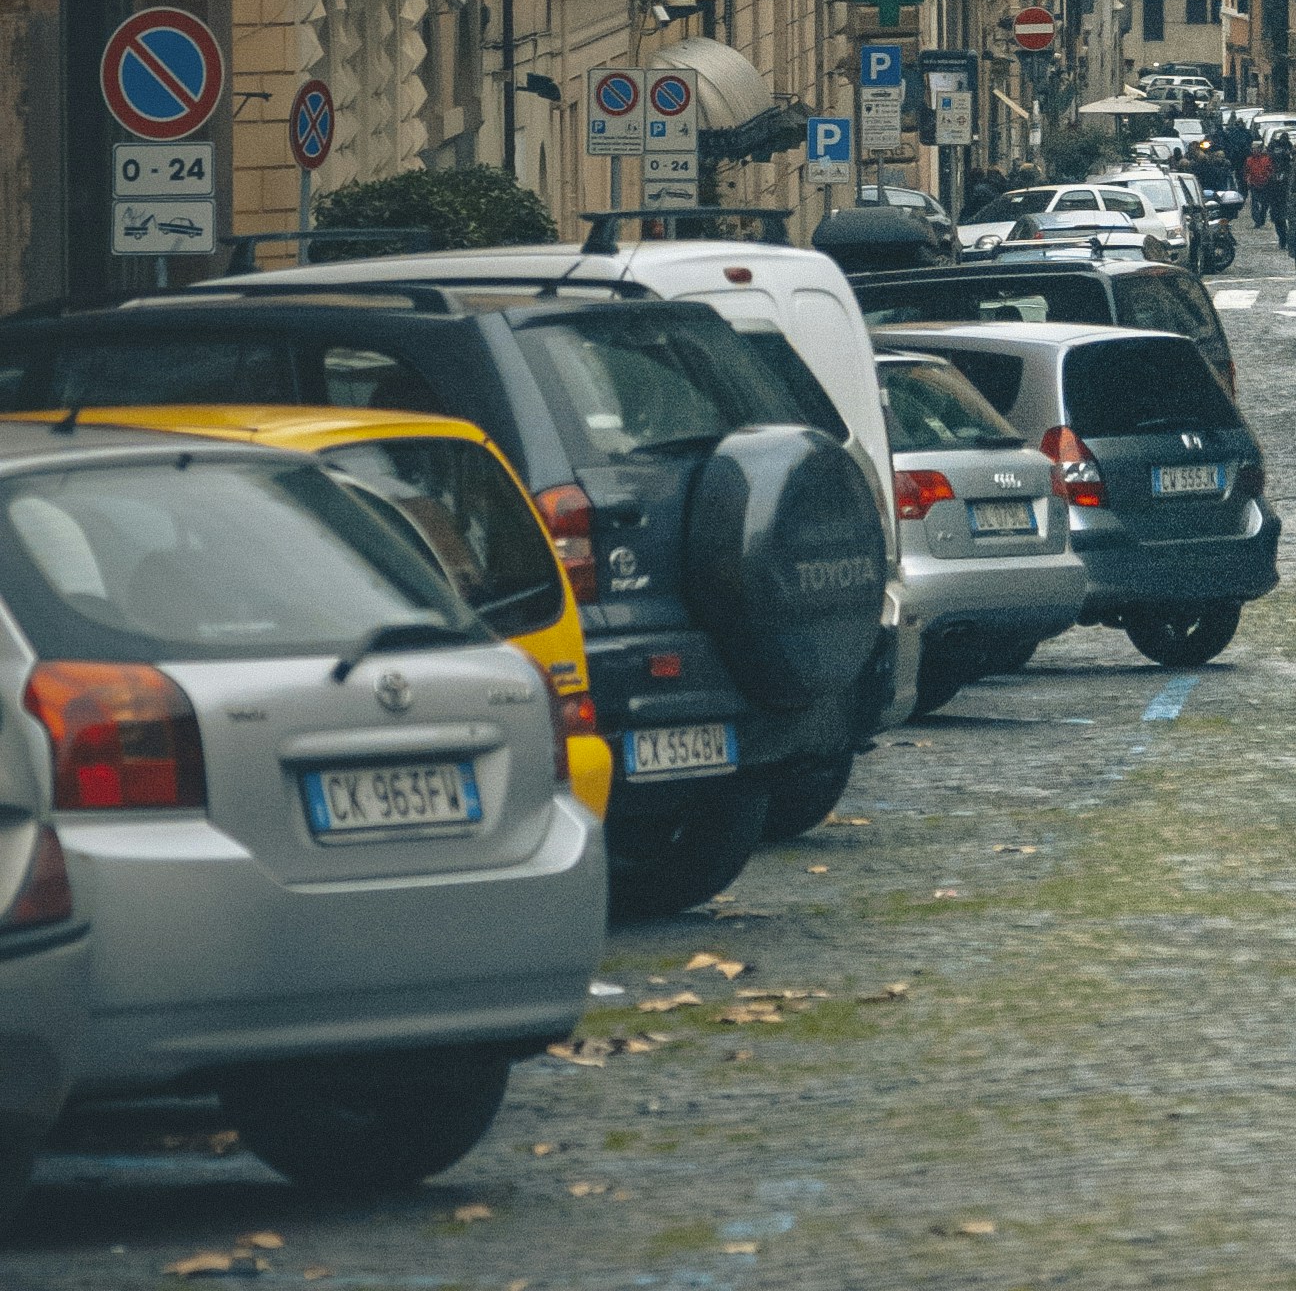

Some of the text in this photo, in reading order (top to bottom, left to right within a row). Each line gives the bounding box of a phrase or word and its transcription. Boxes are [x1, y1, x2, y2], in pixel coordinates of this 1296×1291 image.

[869, 52, 892, 81] P
[593, 120, 605, 133] P
[652, 123, 665, 136] P
[816, 123, 842, 156] P
[168, 157, 206, 181] 24
[671, 160, 689, 172] 24
[795, 557, 876, 591] TOYOTA
[637, 732, 660, 767] CX
[329, 769, 460, 821] CK 963FW
